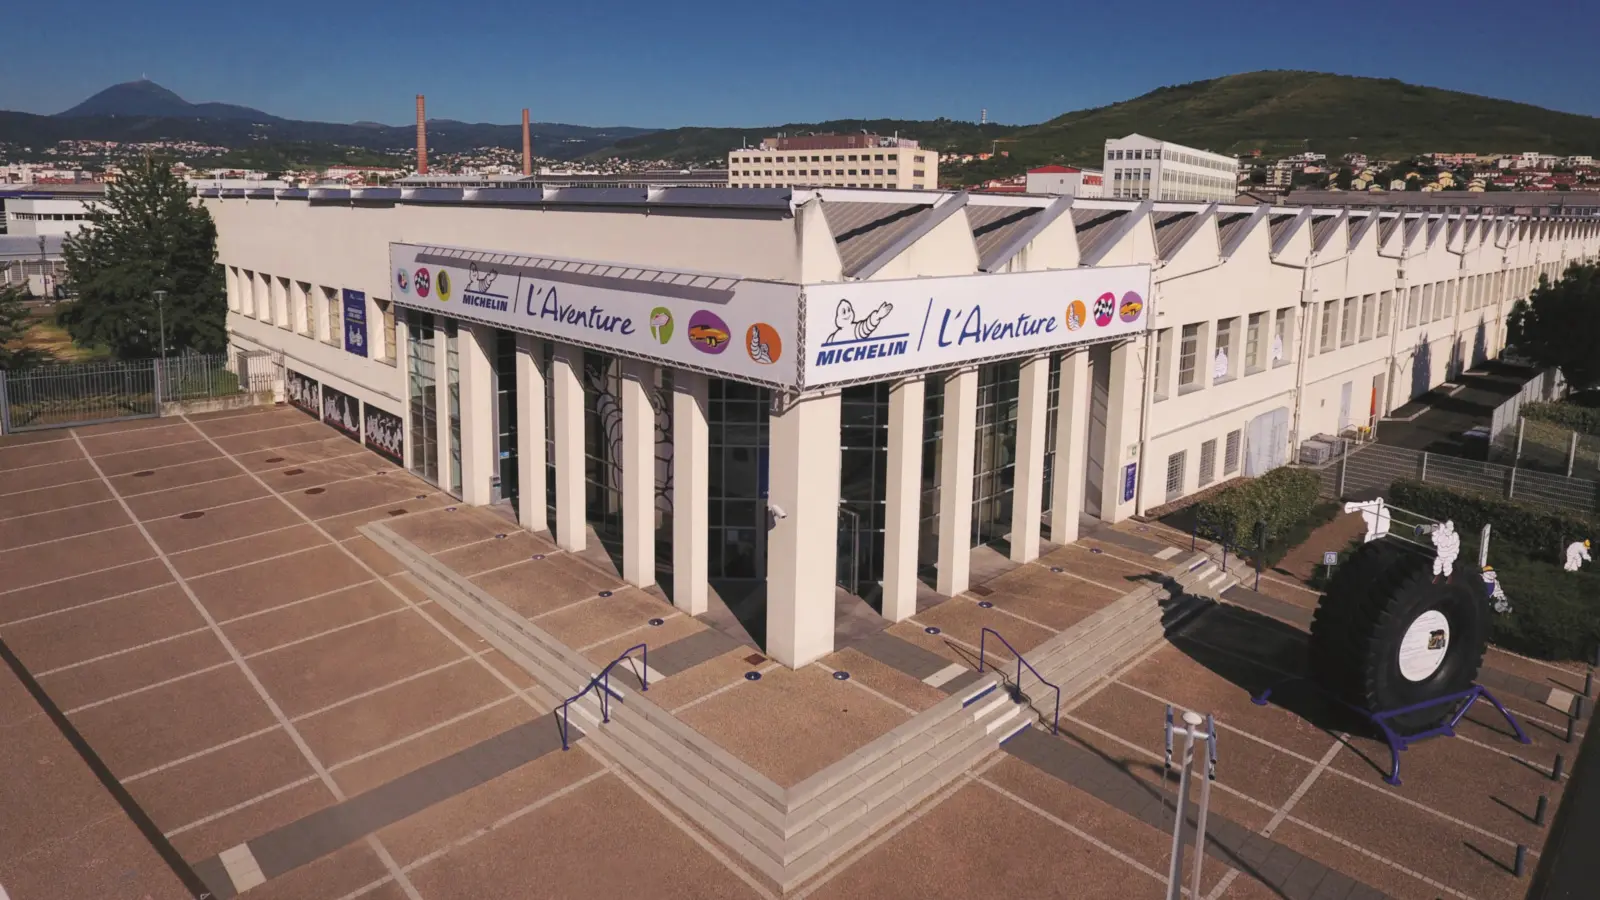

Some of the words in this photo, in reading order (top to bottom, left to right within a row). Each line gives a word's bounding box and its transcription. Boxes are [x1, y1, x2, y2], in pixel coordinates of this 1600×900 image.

[462, 294, 508, 312] MICHELIN
[526, 283, 635, 335] L'Aventure
[938, 304, 1058, 347] L'Aventure
[815, 340, 908, 366] MICHELIN
